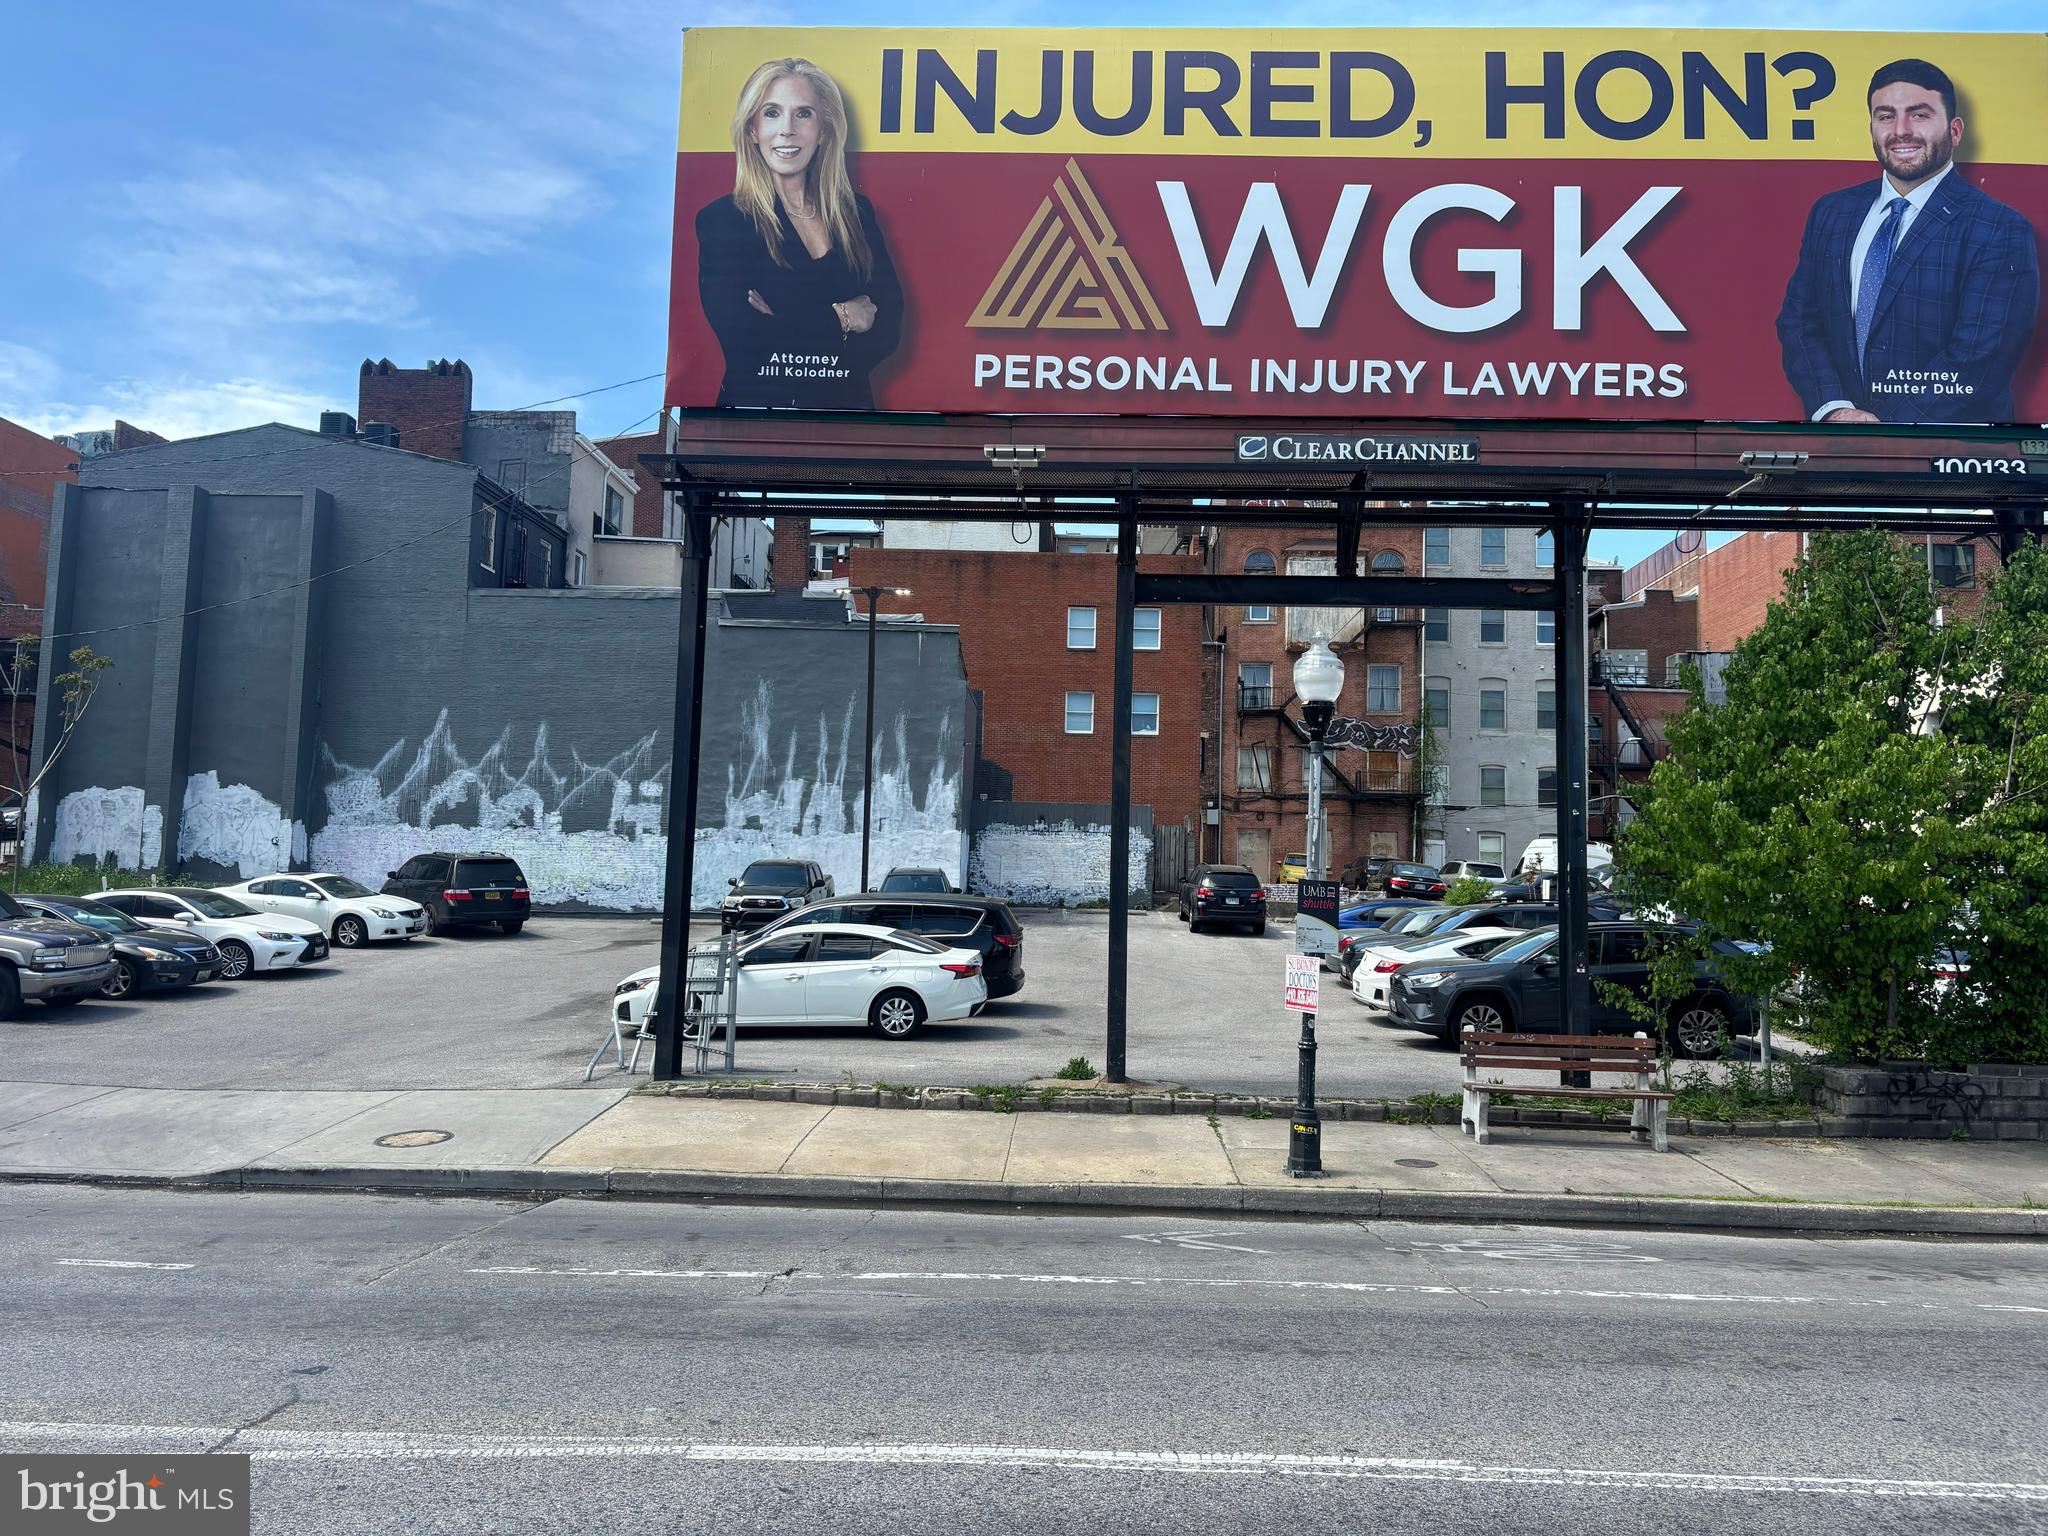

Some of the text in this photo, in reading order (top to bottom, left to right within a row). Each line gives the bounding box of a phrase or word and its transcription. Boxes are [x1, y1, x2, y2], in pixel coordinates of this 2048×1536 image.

[880, 48, 1837, 148] INJURED, HON?
[1156, 181, 1687, 333] WGK
[770, 353, 839, 366] Attorney
[757, 366, 850, 378] Jill Kolodner
[974, 354, 1686, 398] PERSONAL INJURY LAWYERS
[1887, 369, 1959, 383] Attorney
[1872, 382, 1974, 394] Hunter Duke
[1303, 885, 1326, 897] UMB
[1303, 898, 1335, 909] shuttle
[1288, 972, 1317, 989] DOCTORS
